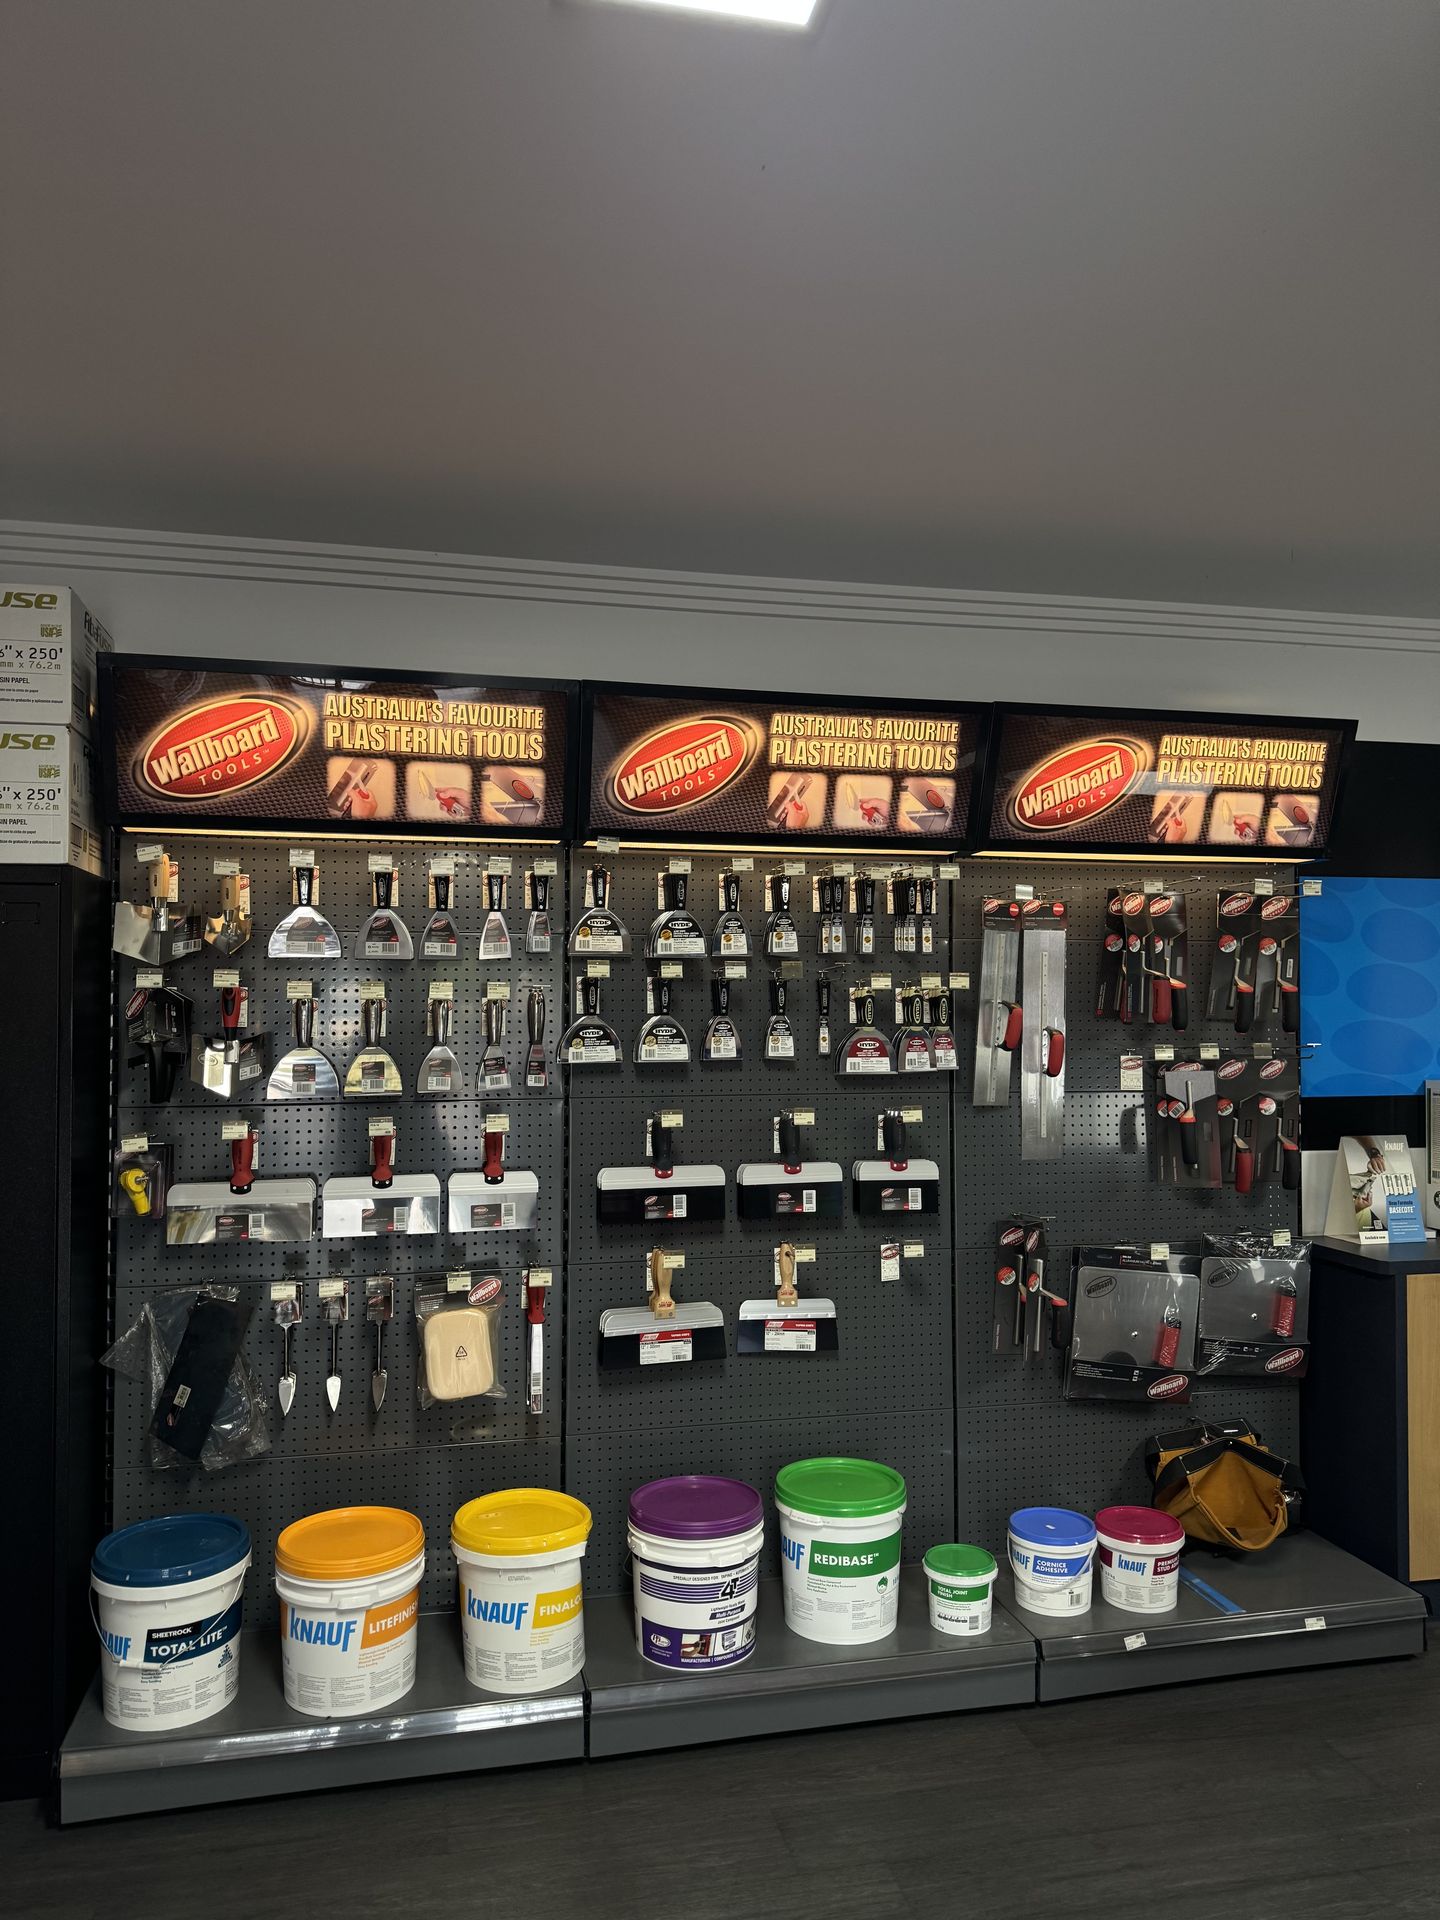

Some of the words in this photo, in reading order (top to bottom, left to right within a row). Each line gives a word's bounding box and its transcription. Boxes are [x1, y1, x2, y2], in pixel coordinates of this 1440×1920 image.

[15, 650, 24, 658] x
[29, 647, 63, 660] 250'
[324, 694, 444, 723] AUSTRALIA'S
[447, 702, 544, 730] FAVOURITE
[325, 720, 469, 756] PLASTERING
[473, 730, 544, 760] TOOLS
[771, 714, 873, 739] AUSTRALIA'S
[876, 720, 959, 742] FAVOURITE
[151, 708, 281, 785] Wallboard
[770, 739, 893, 769] PLASTERING
[896, 744, 957, 771] TOOLS
[1160, 736, 1251, 759] AUSTRALIA'S
[1253, 741, 1327, 762] FAVOURITE
[199, 751, 263, 786] TOOLS
[620, 728, 734, 801] Wallboard
[1157, 758, 1267, 787] PLASTERING
[1269, 763, 1324, 789] TOOLS
[13, 791, 22, 800] x
[26, 788, 61, 801] 250'
[660, 769, 716, 801] TOOLS
[1022, 750, 1124, 819] Wallboard
[1055, 788, 1107, 819] TOOLS
[581, 1029, 602, 1037] HYDE
[1384, 1140, 1404, 1153] KNAUF
[469, 1280, 497, 1303] Wallboard
[1268, 1349, 1299, 1370] Wallboard
[1149, 1377, 1183, 1396] Wallboard
[1035, 1565, 1068, 1574] ADHESIVE
[1036, 1559, 1067, 1568] CORNICE
[1118, 1554, 1148, 1576] KNAUF
[937, 1585, 952, 1594] TOTAL
[468, 1588, 529, 1631] KNAUF
[151, 1626, 193, 1639] SHEETROCK
[290, 1607, 358, 1652] KNAUF
[150, 1640, 196, 1657] TOTAL
